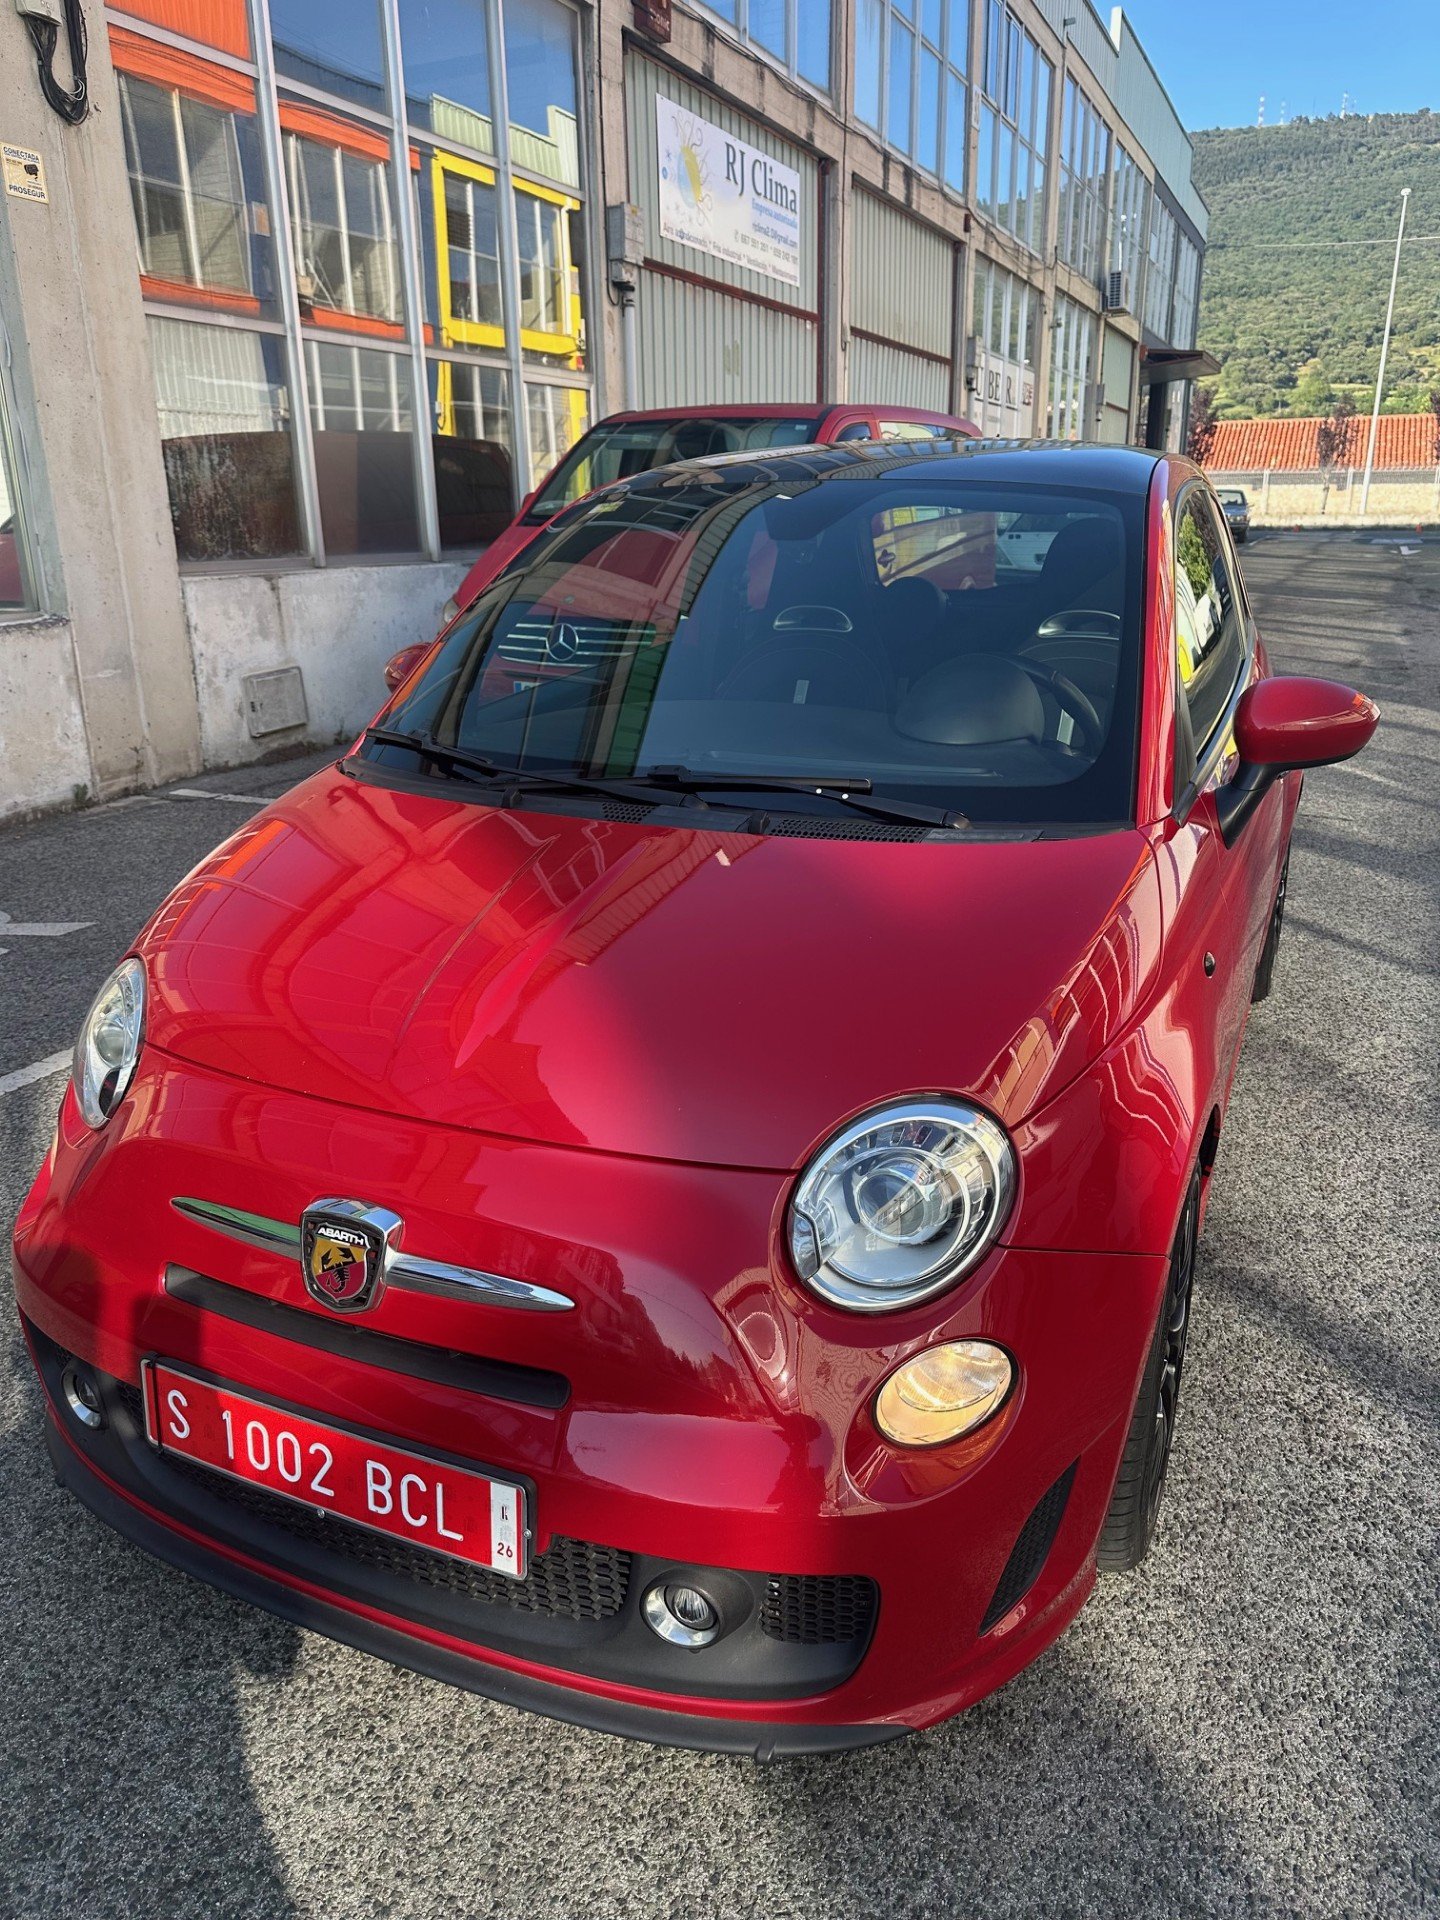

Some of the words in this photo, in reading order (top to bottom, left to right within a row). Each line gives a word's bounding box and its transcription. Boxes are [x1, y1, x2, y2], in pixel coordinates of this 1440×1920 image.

[3, 146, 39, 161] CONECTADA
[725, 141, 746, 197] RJ
[751, 158, 798, 215] Clima
[9, 184, 46, 199] PROSEGUR
[317, 1227, 364, 1245] ABARTH
[167, 1389, 190, 1439] S
[222, 1409, 335, 1497] 1002
[366, 1459, 464, 1542] BCL
[497, 1542, 513, 1558] 26
